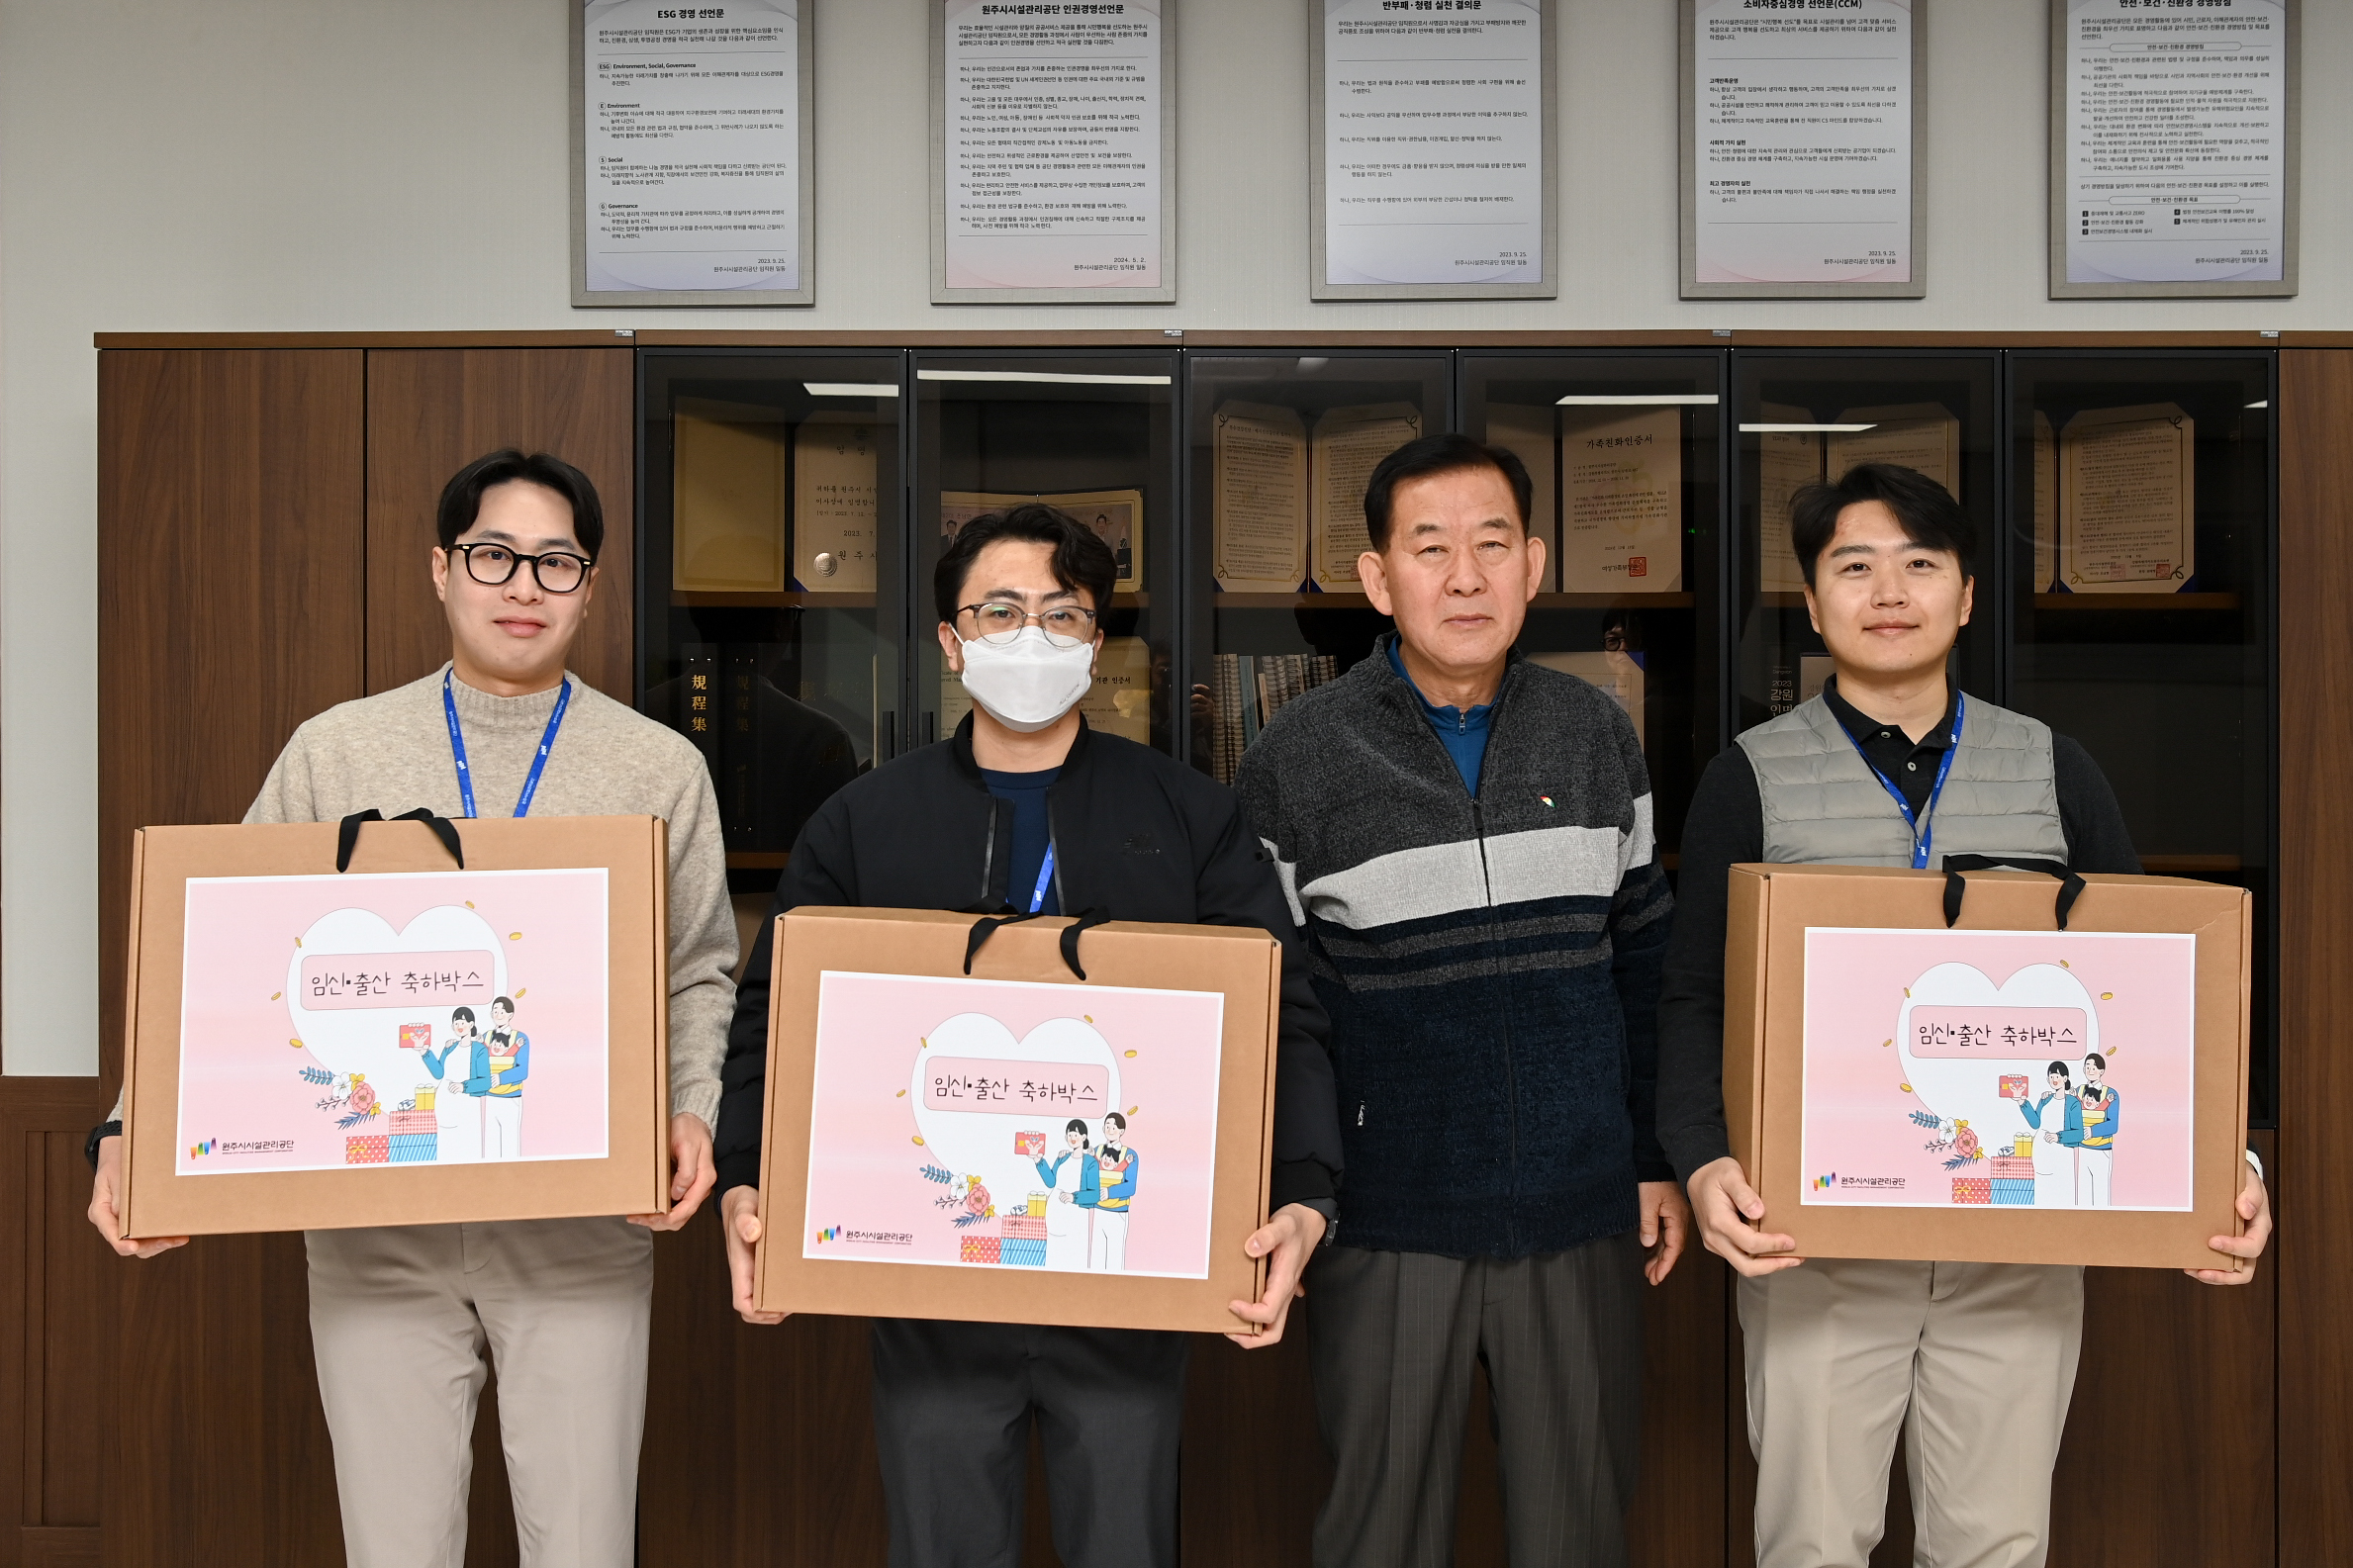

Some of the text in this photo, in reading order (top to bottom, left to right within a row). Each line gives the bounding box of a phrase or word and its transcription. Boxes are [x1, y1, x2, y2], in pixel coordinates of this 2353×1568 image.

[982, 4, 1124, 14] 원주시시설관리공단 인권경영선언문
[1383, 0, 1482, 10] 반부패·청렴 실천 결의문
[1744, 0, 1862, 9] 소비자중심경영 선언문(CCM)
[679, 9, 695, 18] 경영
[699, 9, 724, 18] 선언문
[1587, 434, 1653, 449] 가족친화인증서
[841, 485, 861, 493] 원주시
[1771, 689, 1793, 701] 강원
[691, 674, 707, 732] 規程集
[401, 970, 484, 993] 축하박스
[2000, 1024, 2077, 1046] 축하박스
[1019, 1079, 1098, 1104] 축하박스
[222, 1140, 294, 1151] 원주시시설관리공단
[1841, 1177, 1906, 1186] 원주시시설관리공단
[846, 1230, 913, 1242] 원주시시설관리공단
